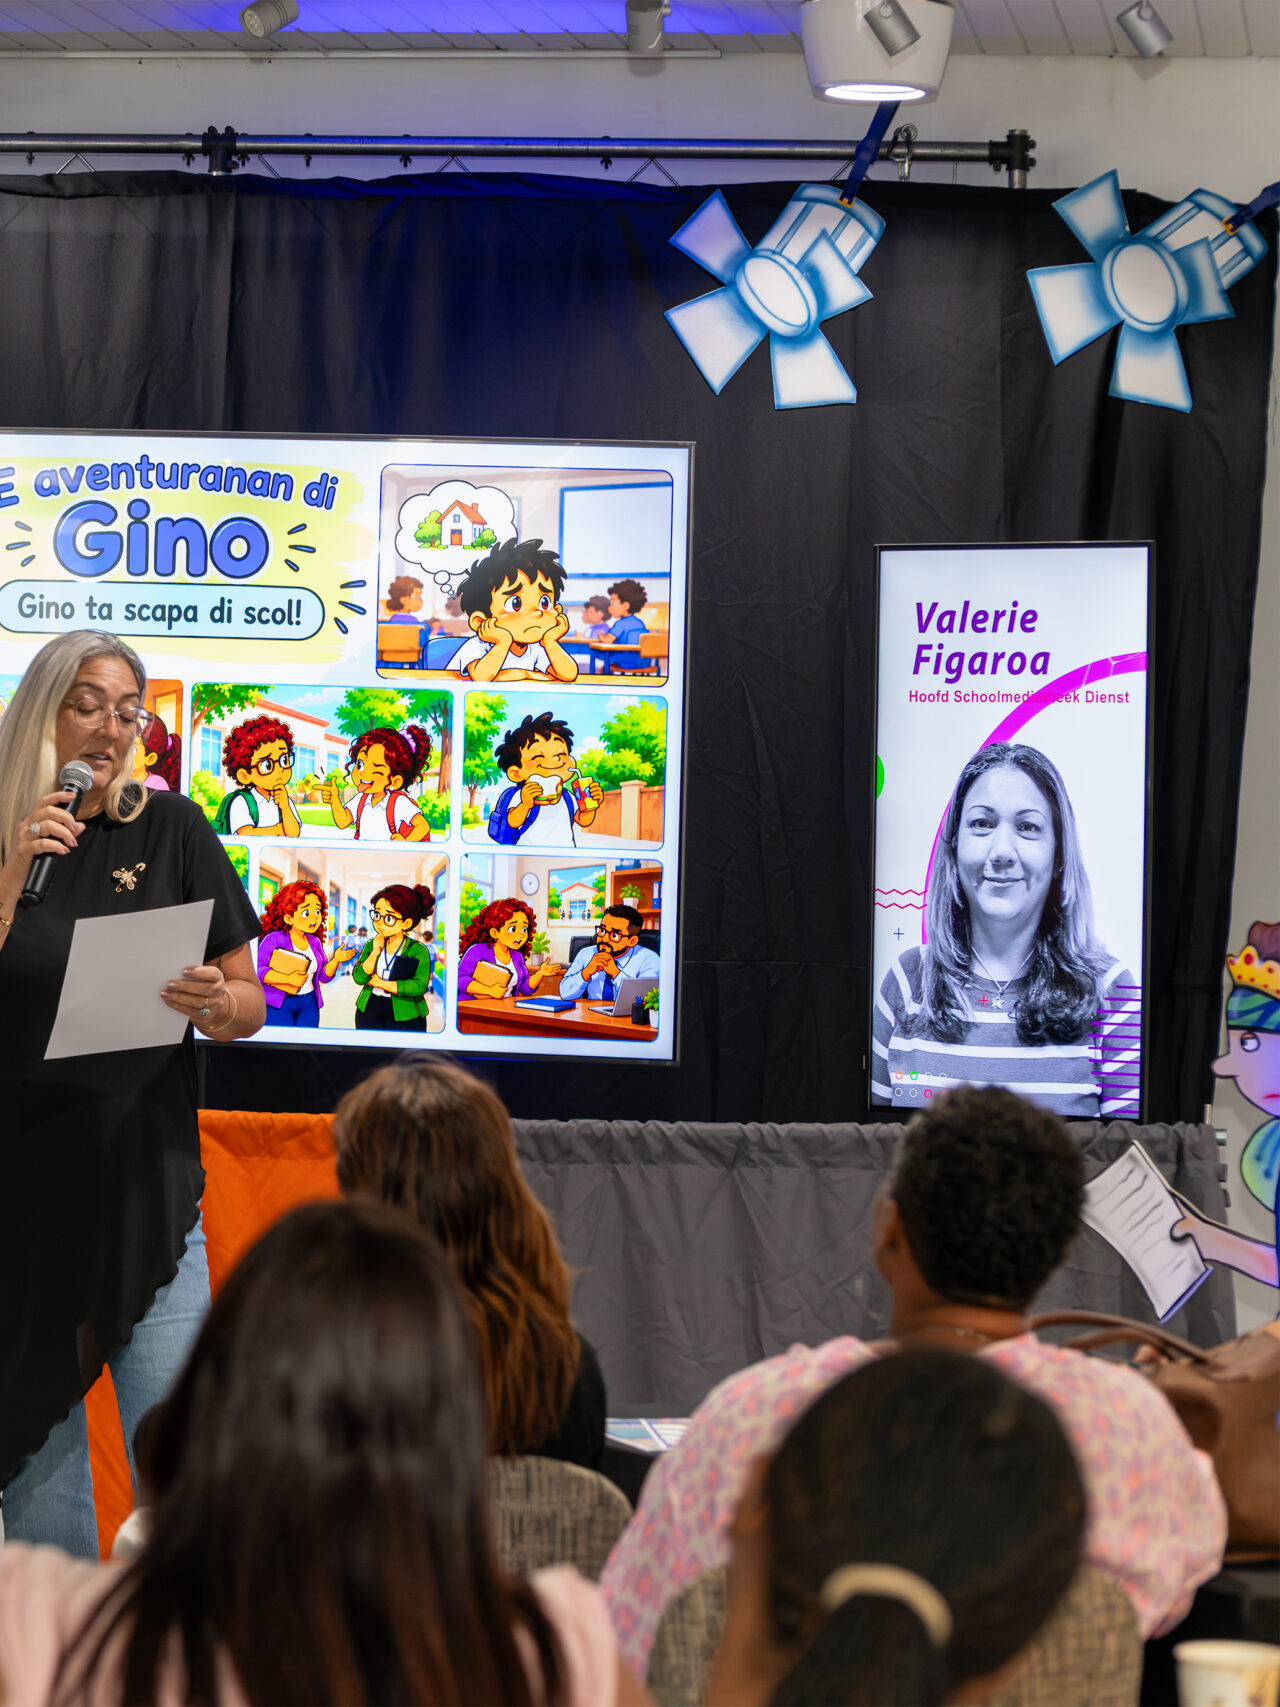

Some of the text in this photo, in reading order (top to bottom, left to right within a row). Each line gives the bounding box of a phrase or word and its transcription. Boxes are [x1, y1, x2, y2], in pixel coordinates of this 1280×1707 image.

[33, 454, 294, 501] aventuranan
[303, 473, 339, 511] di
[53, 498, 270, 579] Gino
[18, 593, 302, 630] Gino ta scapa di scol!
[915, 600, 1039, 634] Valerie
[912, 642, 1051, 684] Figaroa
[909, 690, 949, 703] Hoofd
[1085, 690, 1130, 704] Dienst
